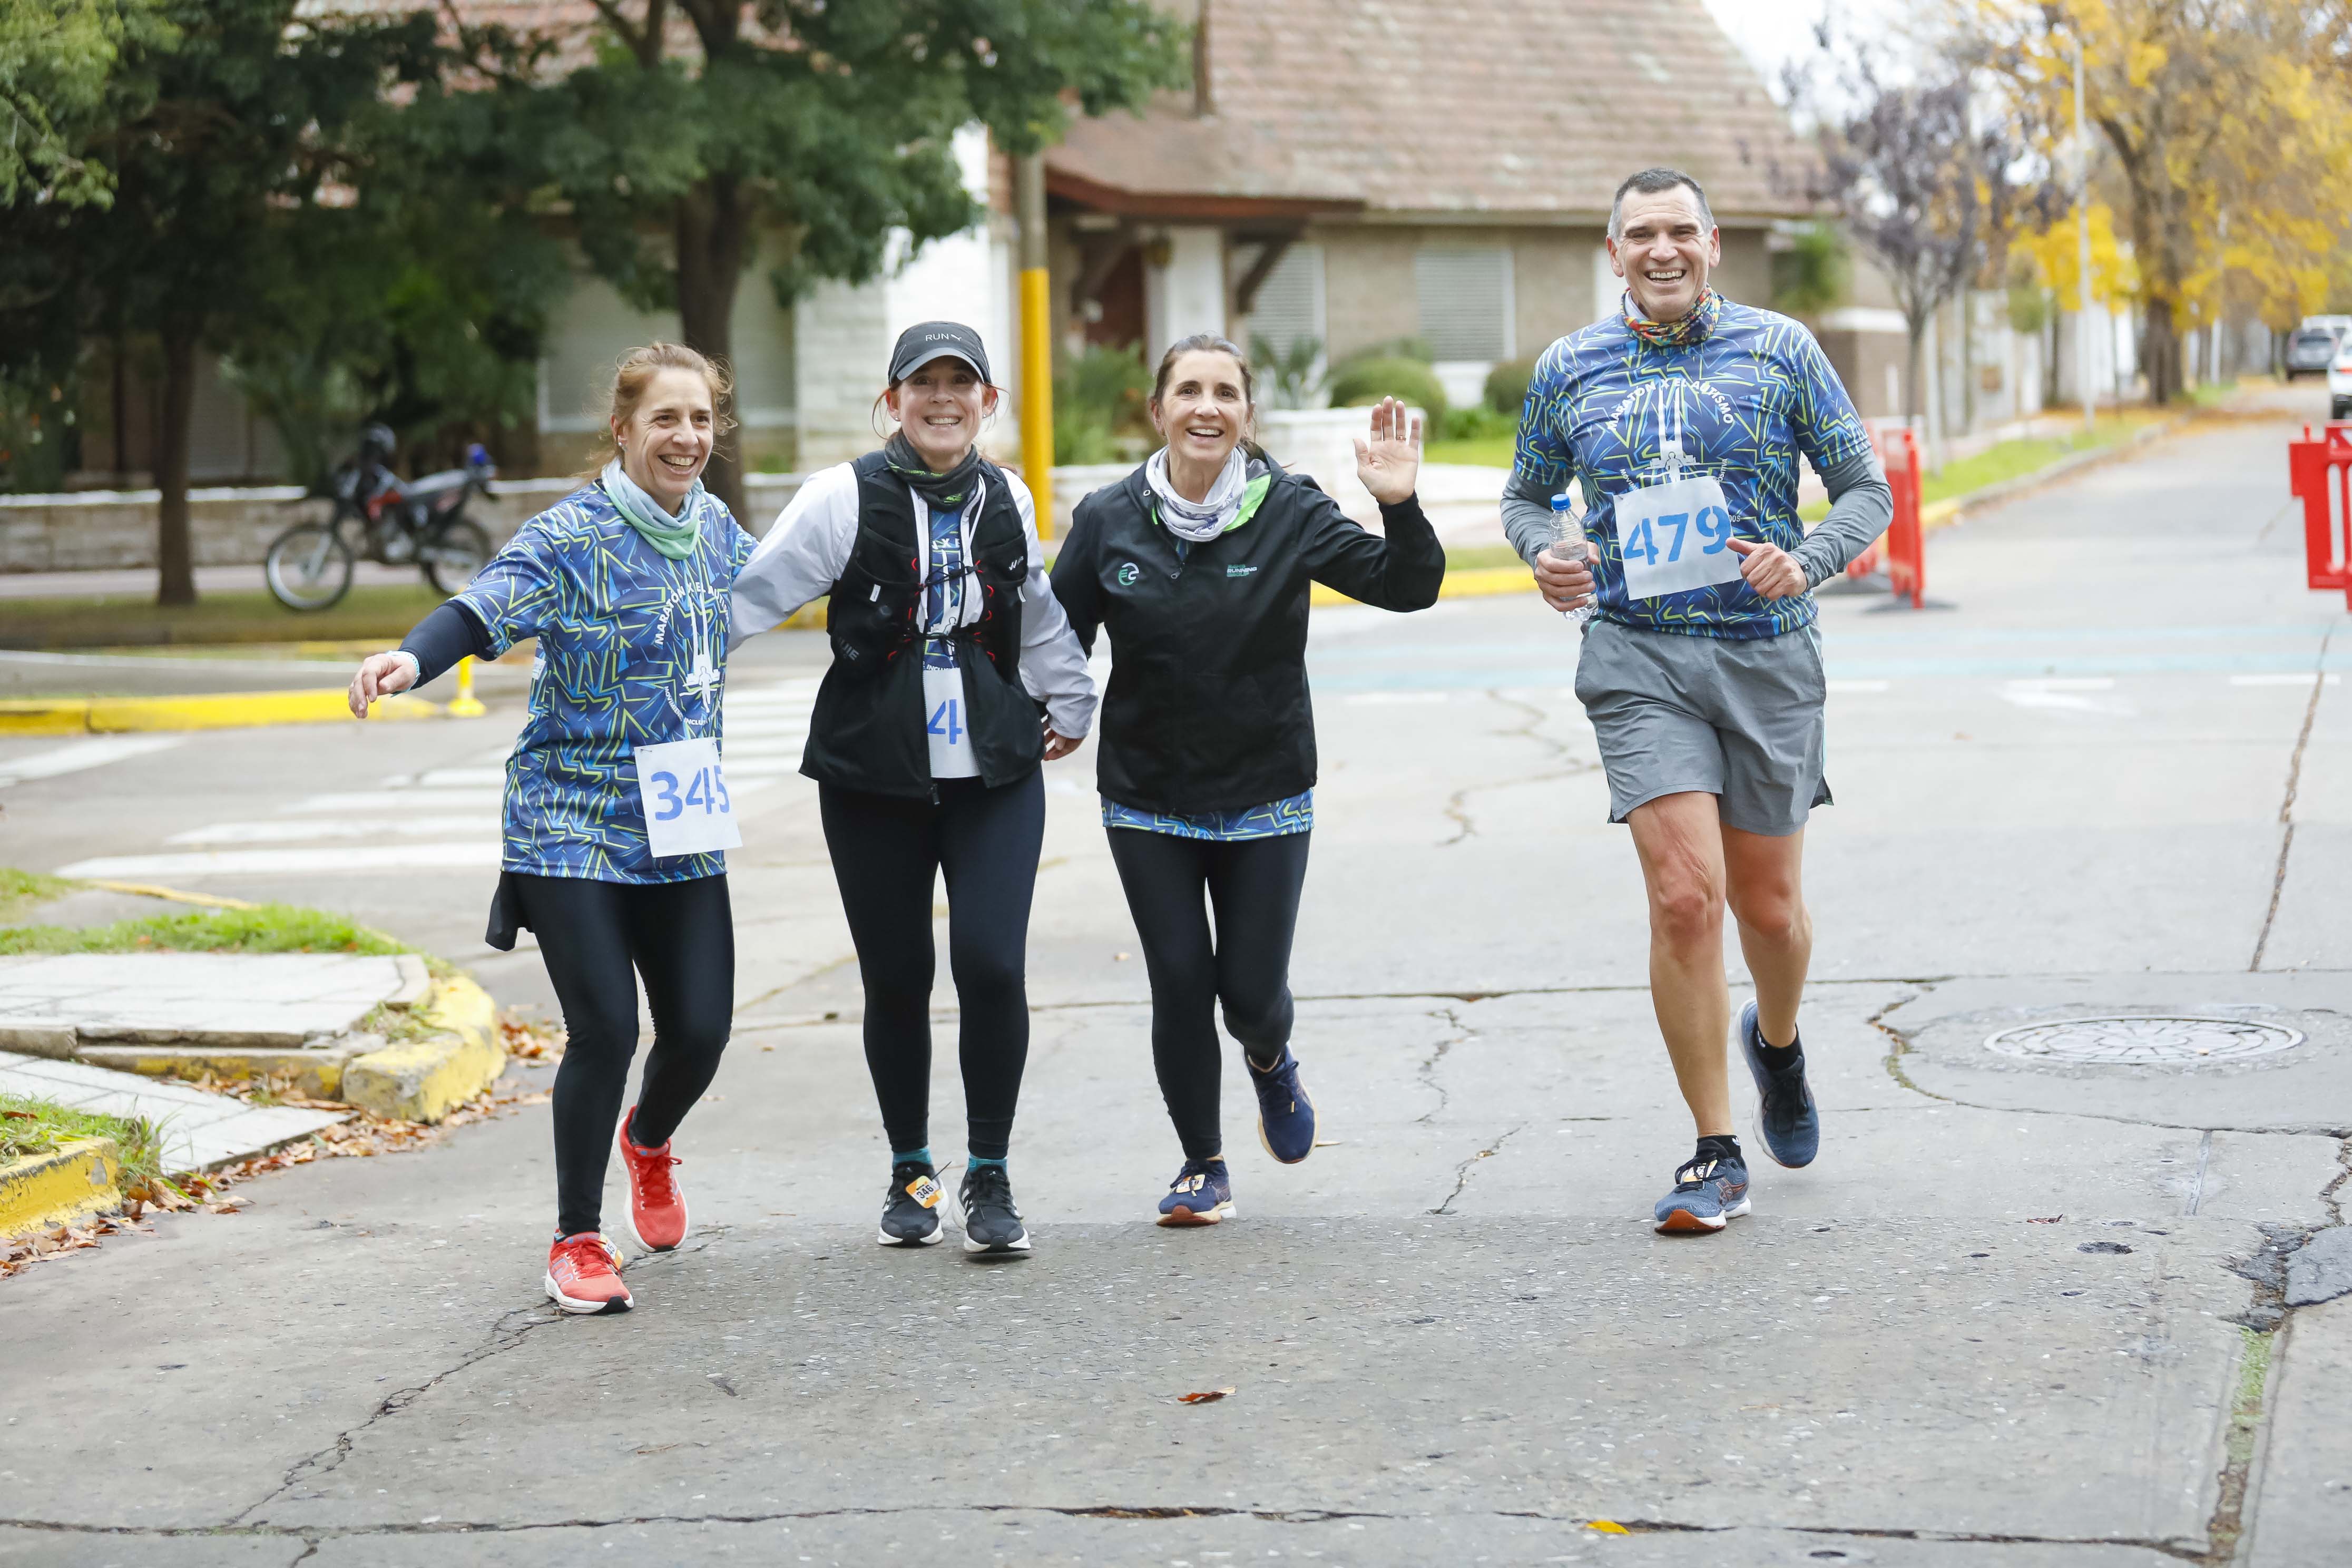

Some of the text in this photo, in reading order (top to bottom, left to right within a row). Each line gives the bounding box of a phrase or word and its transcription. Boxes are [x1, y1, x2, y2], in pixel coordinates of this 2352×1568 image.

[926, 333, 949, 341] RUN
[1661, 378, 1670, 389] X
[1674, 378, 1687, 387] EL
[1691, 380, 1734, 424] AUTISMO
[1623, 505, 1731, 565] 479
[695, 582, 707, 593] EL
[651, 765, 730, 821] 345
[916, 1184, 934, 1199] 346
[606, 1243, 615, 1255] 45
